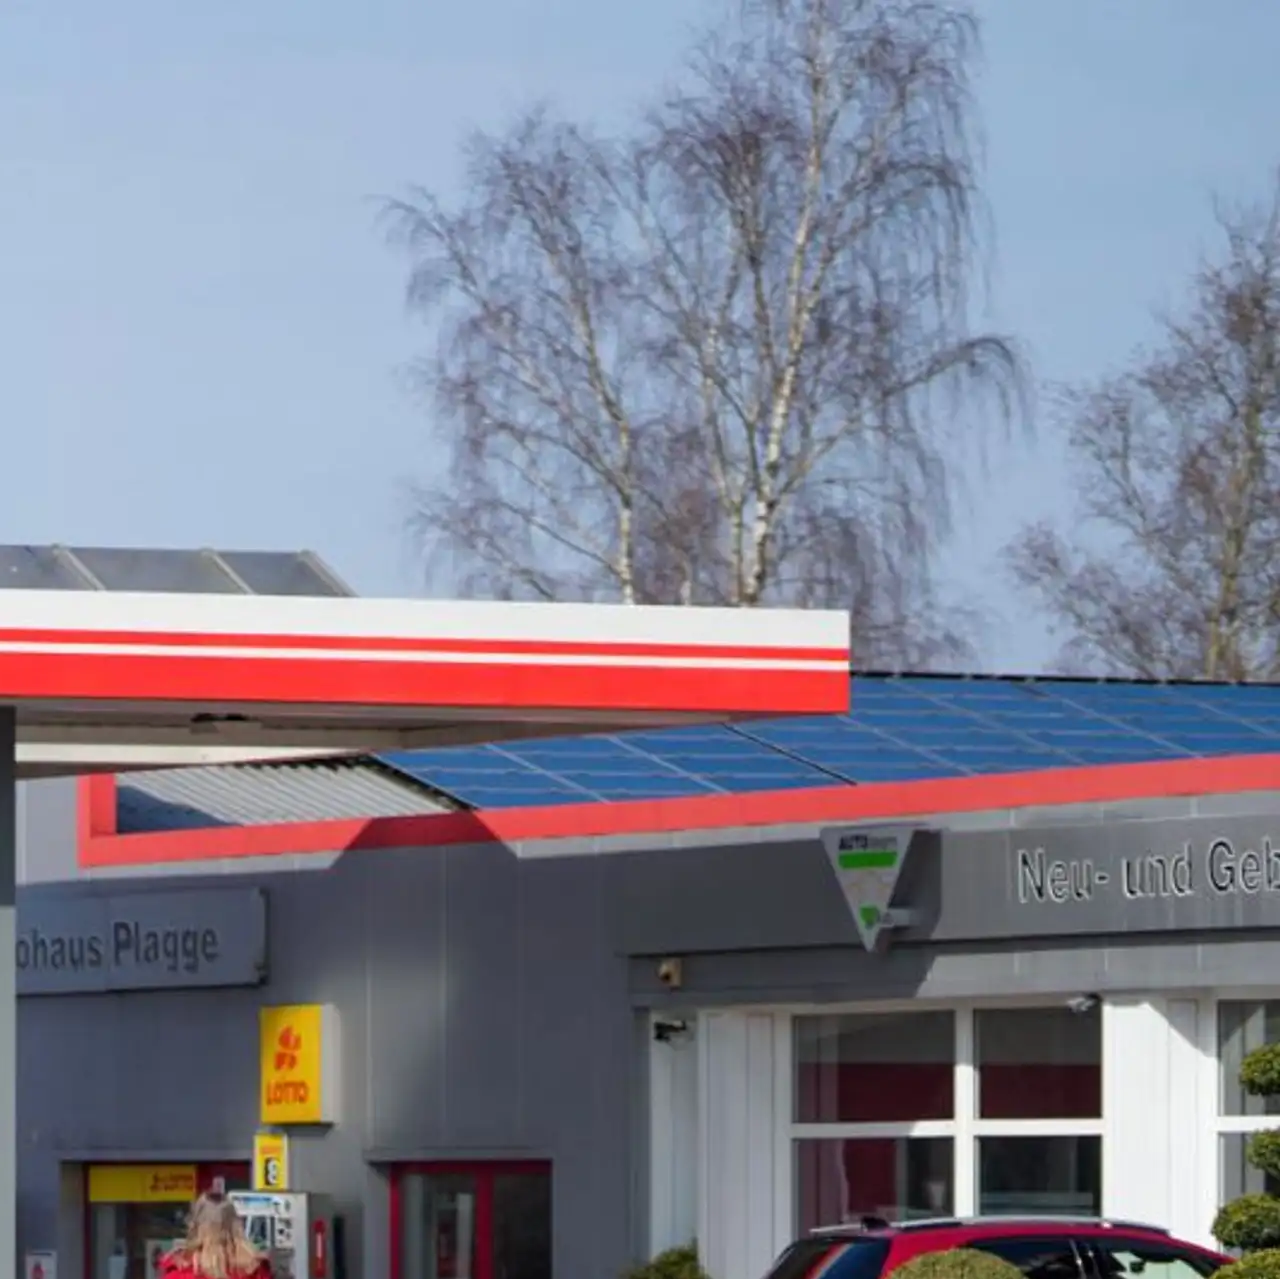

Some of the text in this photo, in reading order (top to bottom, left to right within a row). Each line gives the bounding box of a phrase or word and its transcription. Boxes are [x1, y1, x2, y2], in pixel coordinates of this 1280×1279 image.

[1018, 847, 1109, 904] Neu-
[1121, 841, 1194, 899] und
[113, 921, 219, 973] Plagge
[266, 1081, 309, 1105] LOTTO
